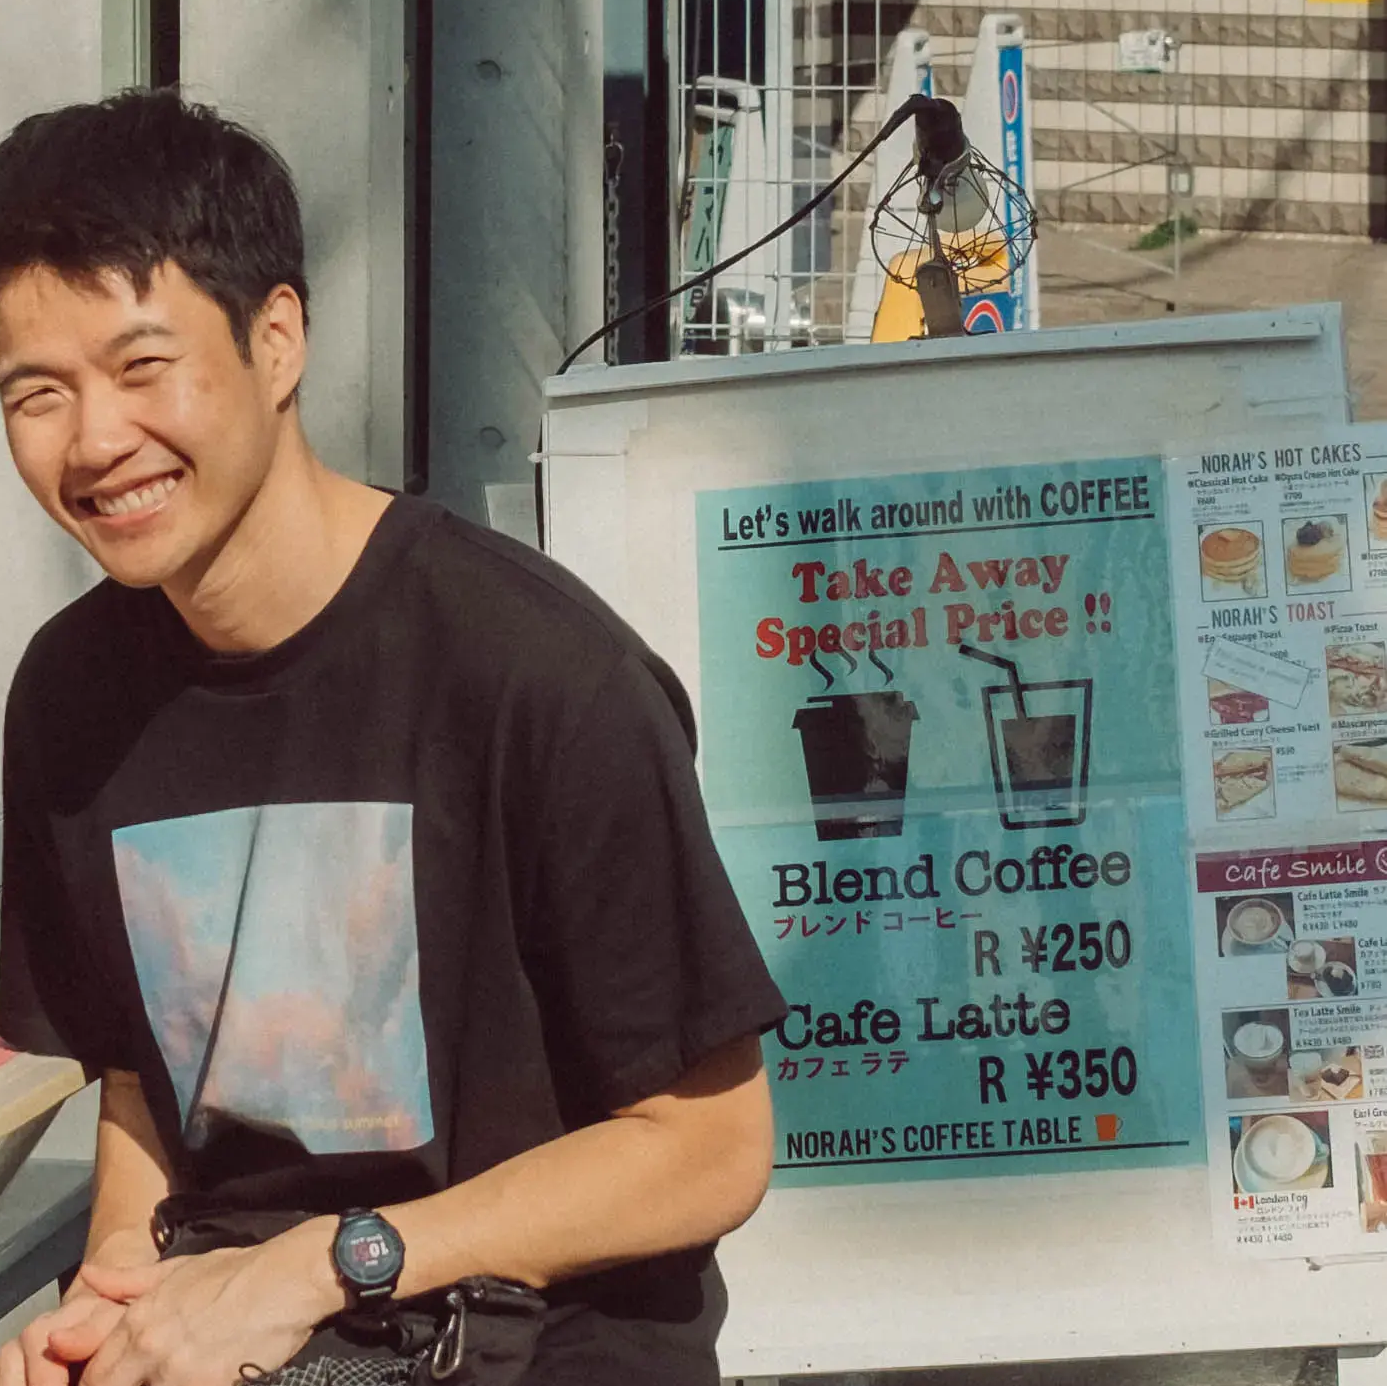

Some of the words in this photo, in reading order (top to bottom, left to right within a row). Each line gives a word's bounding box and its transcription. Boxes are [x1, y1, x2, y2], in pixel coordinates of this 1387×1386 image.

[1201, 451, 1268, 474] NORAH'S
[1274, 447, 1304, 469] HOT
[1311, 443, 1363, 465] CAKES
[722, 504, 790, 542] Let's
[797, 498, 863, 535] walk
[870, 490, 965, 530] around
[971, 482, 1031, 522] with
[1039, 475, 1151, 518] COFFEE
[791, 558, 914, 604] Take
[927, 551, 1071, 595] Away
[755, 606, 930, 667] Special
[942, 599, 1070, 646] Price
[1084, 591, 1112, 635] !!
[1211, 605, 1279, 629] NORAH'S
[1285, 600, 1336, 623] TOAST
[1355, 622, 1379, 632] Toast
[771, 853, 940, 908] Blend
[954, 843, 1132, 897] Coffee
[1297, 891, 1318, 902] Cafe
[1344, 887, 1369, 899] Smile
[773, 910, 872, 941] ブレンド
[883, 906, 984, 933] コーヒー
[1358, 938, 1378, 948] Cafe
[973, 928, 1004, 977] R
[1019, 919, 1133, 974] ¥250
[774, 999, 902, 1052] Cafe
[915, 990, 1072, 1044] Latte
[1336, 1004, 1362, 1016] Smile
[776, 1054, 851, 1083] カフェ
[859, 1049, 911, 1077] ラテ
[978, 1054, 1008, 1105] R
[1025, 1045, 1138, 1101] ¥350
[785, 1124, 896, 1160] NORAH'S
[902, 1119, 996, 1153] COFFEE
[1002, 1115, 1083, 1148] TABLE
